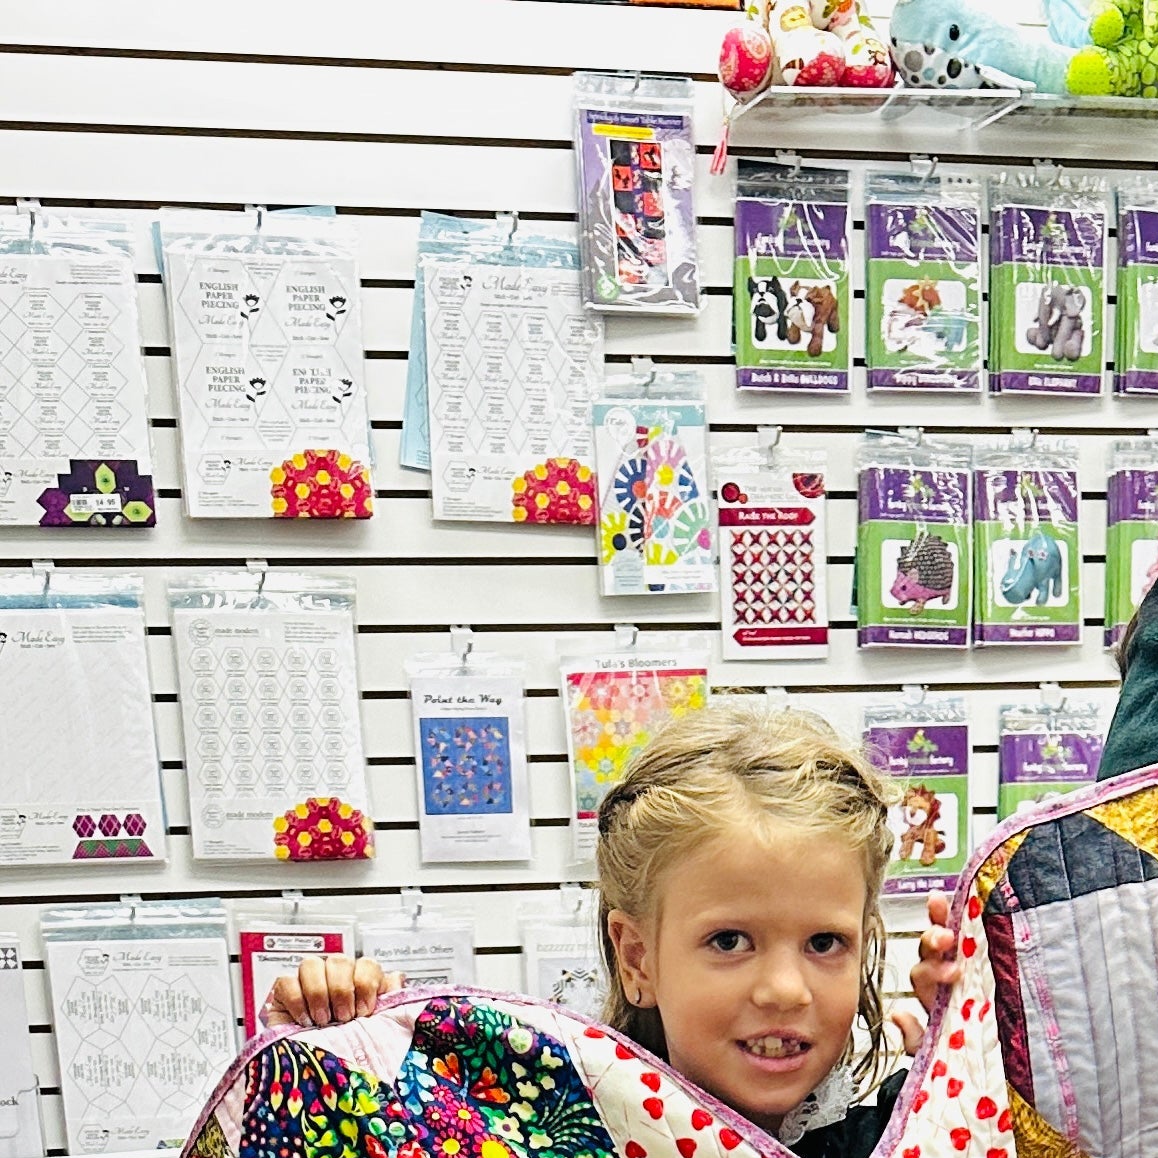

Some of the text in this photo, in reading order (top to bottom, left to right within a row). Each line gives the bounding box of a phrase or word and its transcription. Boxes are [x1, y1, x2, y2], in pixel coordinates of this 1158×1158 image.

[199, 282, 239, 292] ENGLISH
[286, 285, 326, 294] ENGLISH
[206, 291, 233, 300] PAPER
[292, 294, 321, 302] PAPER
[201, 300, 240, 309] PIECING
[288, 302, 326, 311] PIECING
[205, 366, 245, 375] ENGLISH
[212, 375, 240, 384] PAPER
[208, 384, 246, 393] PIECING
[628, 657, 678, 668] Bloomers
[424, 694, 502, 707] Point the Way
[374, 949, 393, 957] Plays
